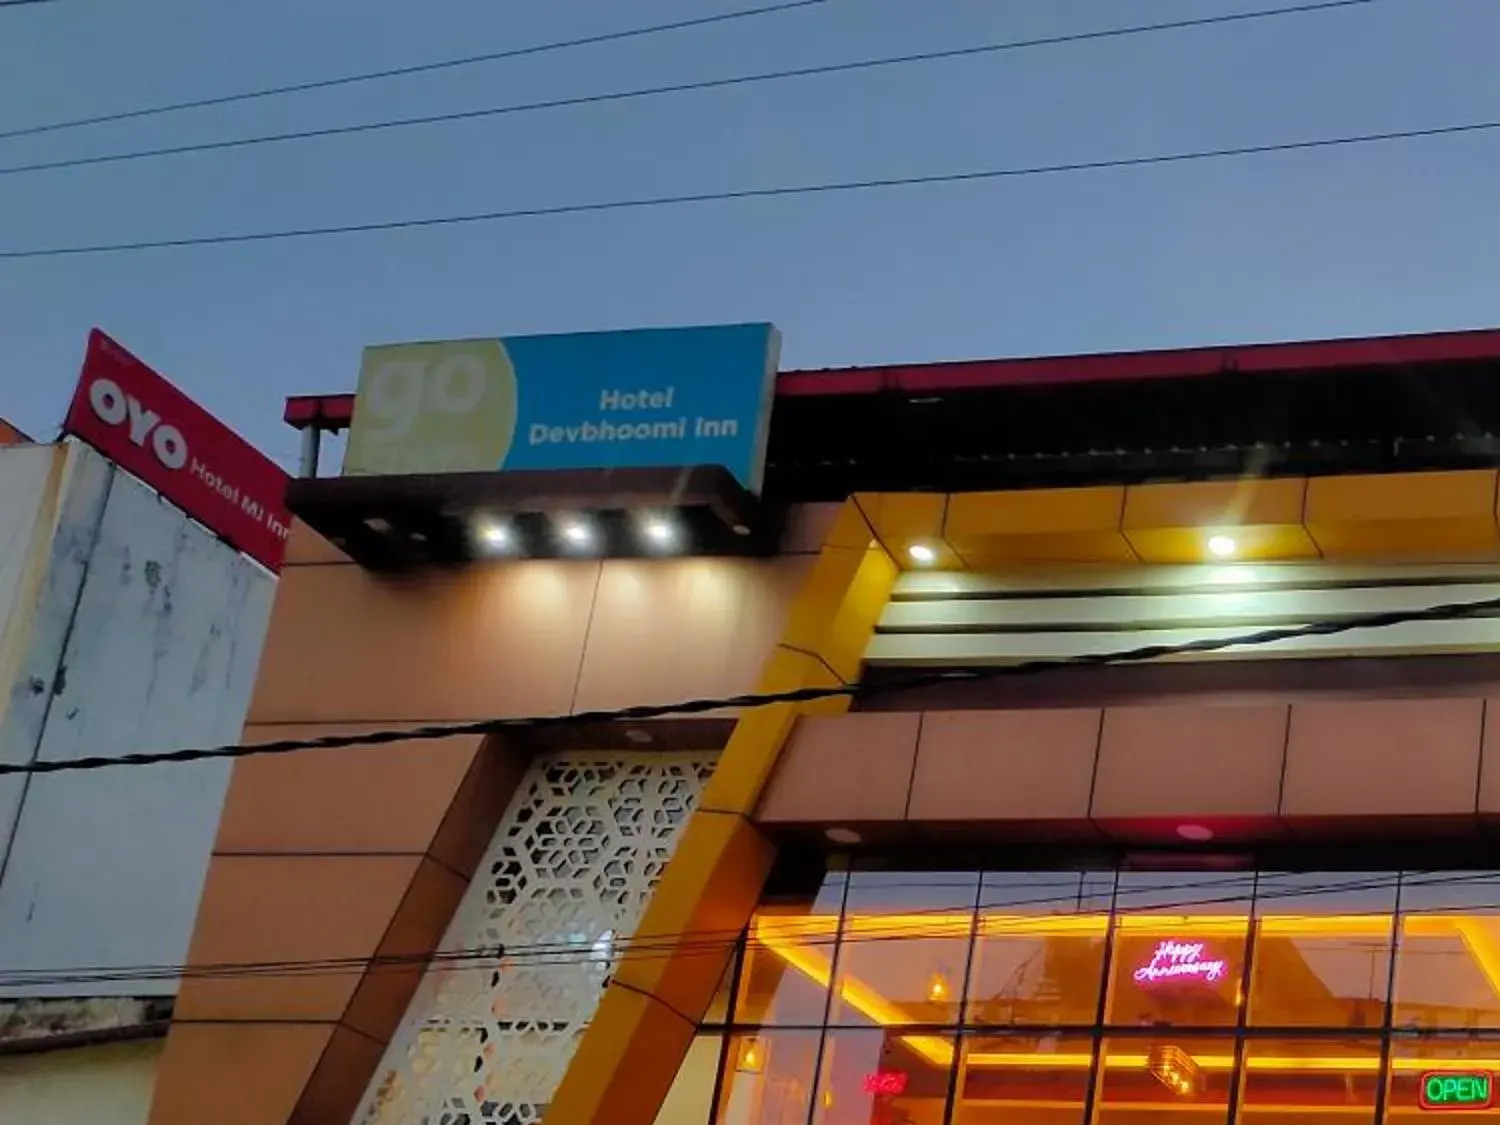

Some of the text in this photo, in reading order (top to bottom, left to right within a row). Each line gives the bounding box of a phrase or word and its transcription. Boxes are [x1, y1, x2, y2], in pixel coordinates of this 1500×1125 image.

[600, 387, 674, 410] Hotel
[90, 378, 188, 470] OYO
[529, 416, 738, 446] Devbhoomi Inn
[189, 455, 239, 504] Hotel
[1153, 940, 1203, 963] Happy
[1426, 1076, 1488, 1101] OPEN
